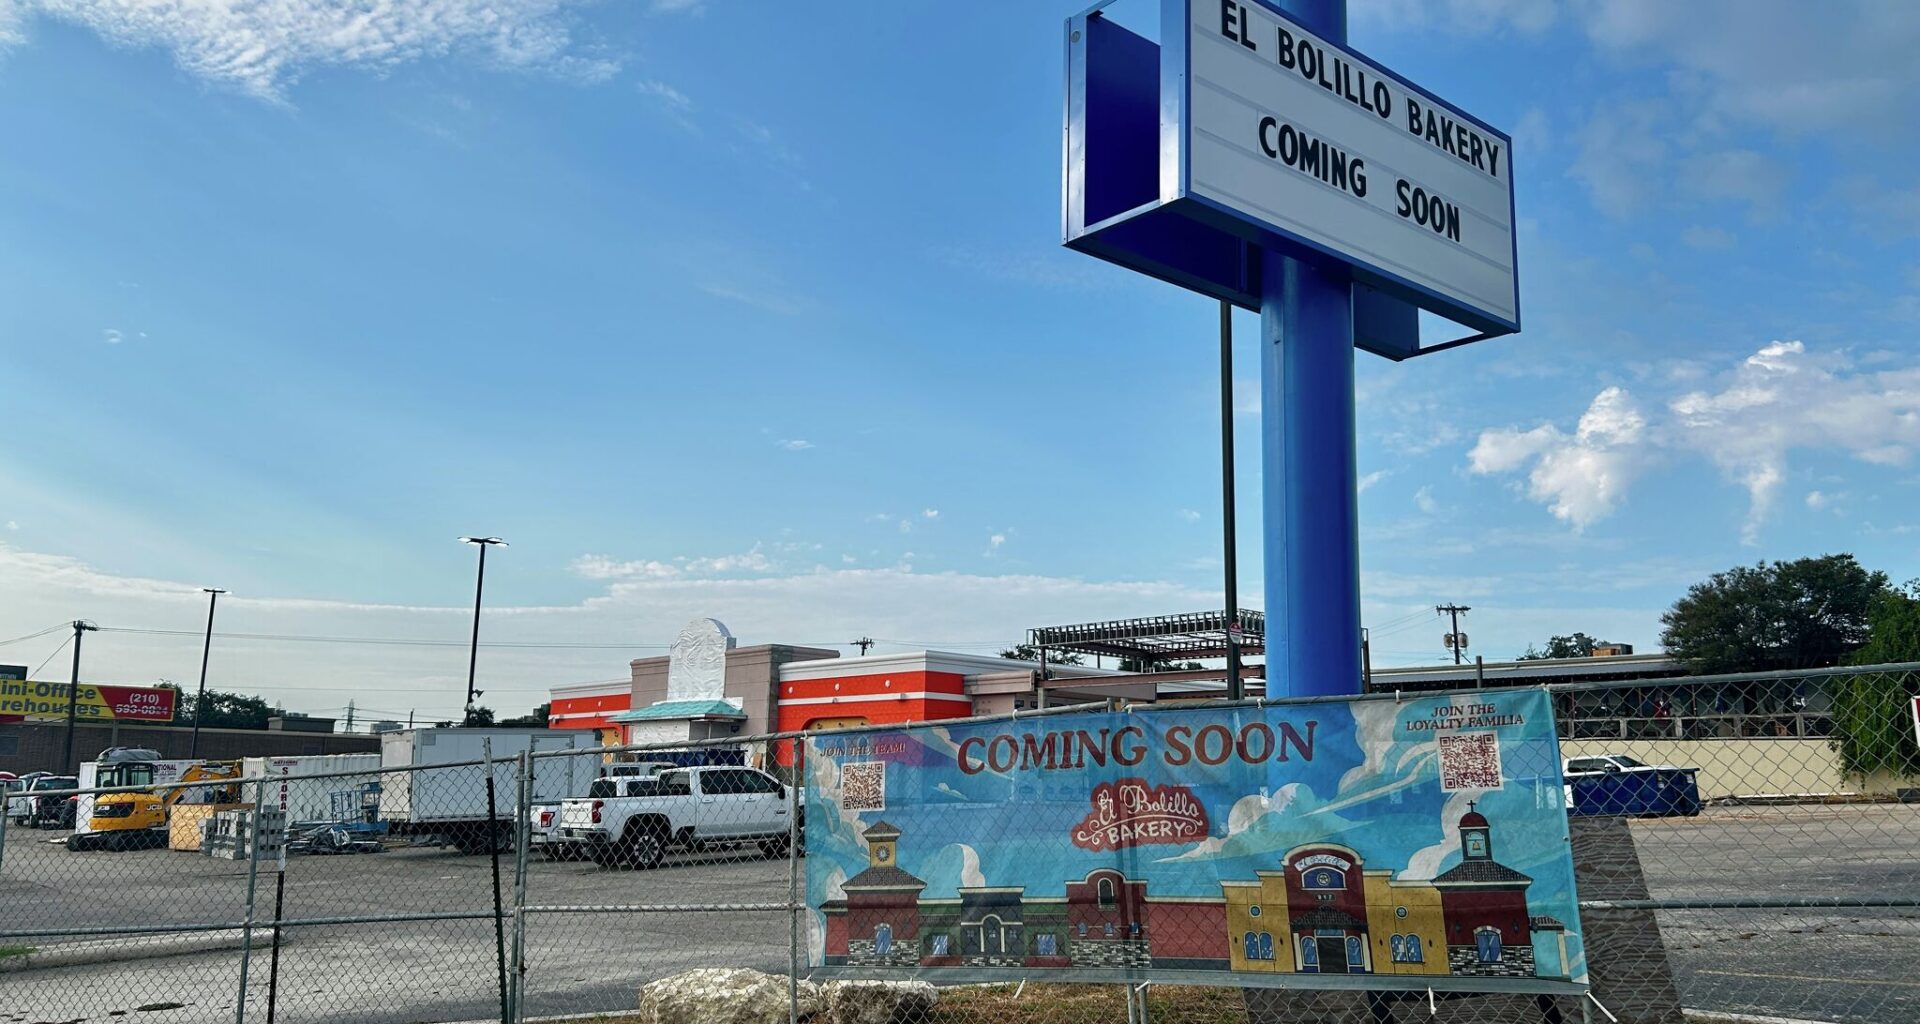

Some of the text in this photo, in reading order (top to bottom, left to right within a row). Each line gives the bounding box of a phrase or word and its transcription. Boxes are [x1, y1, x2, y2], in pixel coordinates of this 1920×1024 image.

[1222, 0, 1498, 177] EL BOLILLO BAKERY
[1258, 116, 1460, 243] COMING SOON
[1, 681, 97, 699] ini-Office
[1, 698, 101, 714] rehouses
[129, 693, 160, 706] (210)
[1431, 703, 1496, 717] JOIN THE
[1406, 714, 1524, 731] LOYALTY FAMILIA
[820, 746, 846, 758] JOIN
[849, 745, 871, 756] THE
[957, 720, 1318, 775] COMING SOON
[1097, 785, 1200, 826] El Bolillo
[1106, 821, 1187, 844] BAKERY
